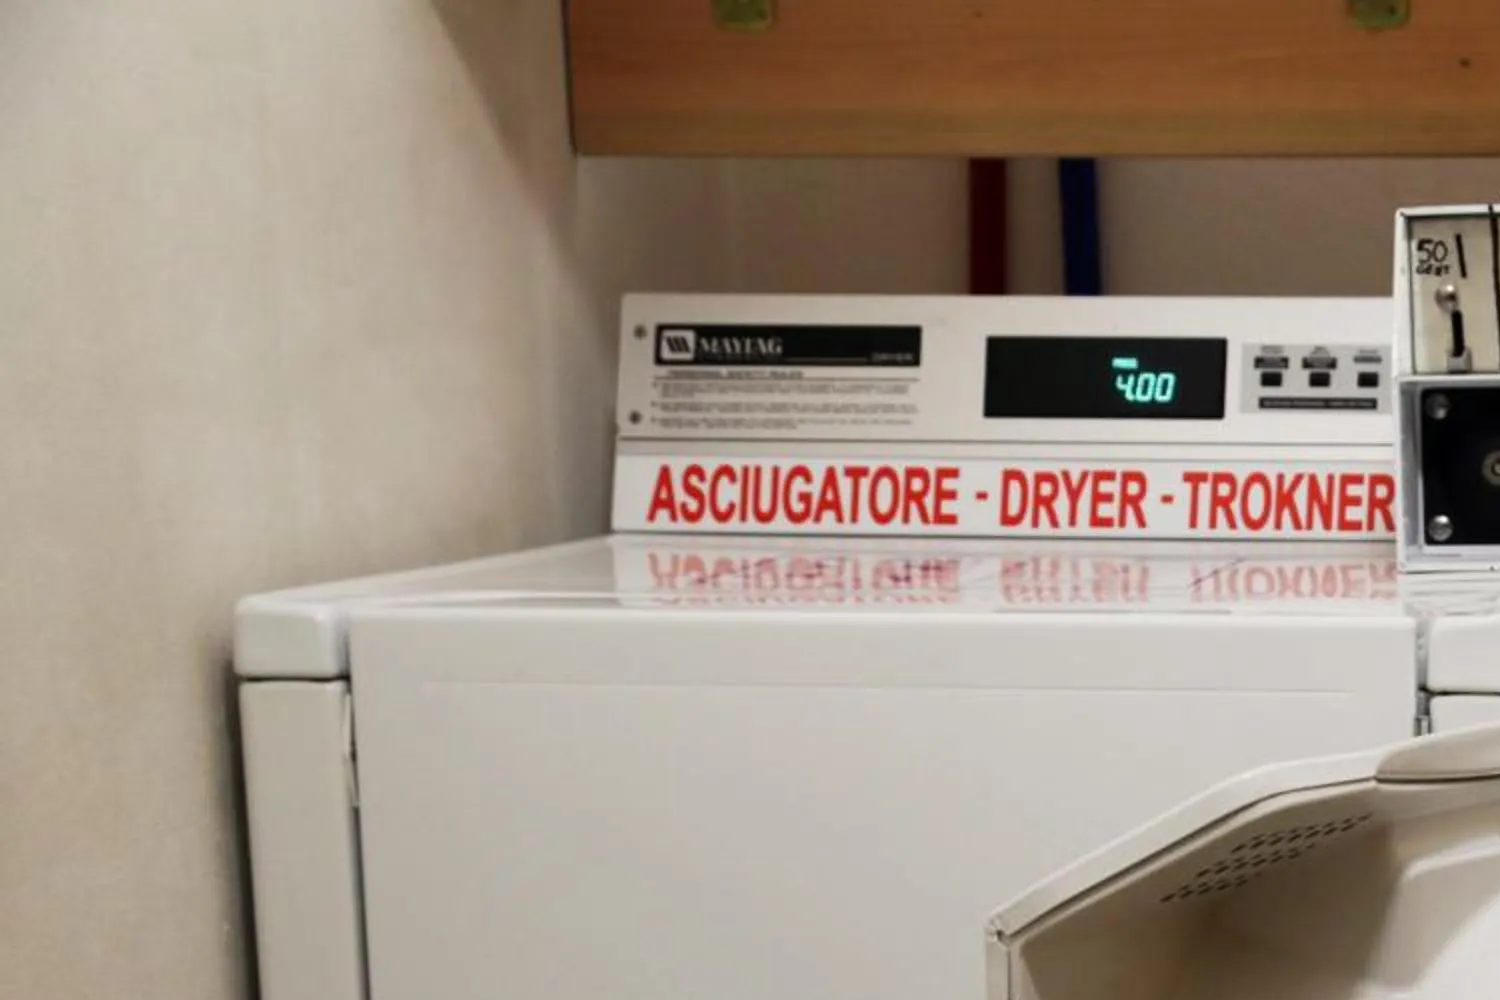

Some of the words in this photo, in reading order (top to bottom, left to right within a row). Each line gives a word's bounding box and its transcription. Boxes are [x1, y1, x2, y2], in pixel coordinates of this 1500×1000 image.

[1416, 238, 1449, 264] 50
[699, 337, 783, 355] MAYTAG
[647, 464, 959, 526] ASCIUGATORE
[999, 468, 1147, 529] DRYER
[1183, 471, 1396, 532] TROKNER
